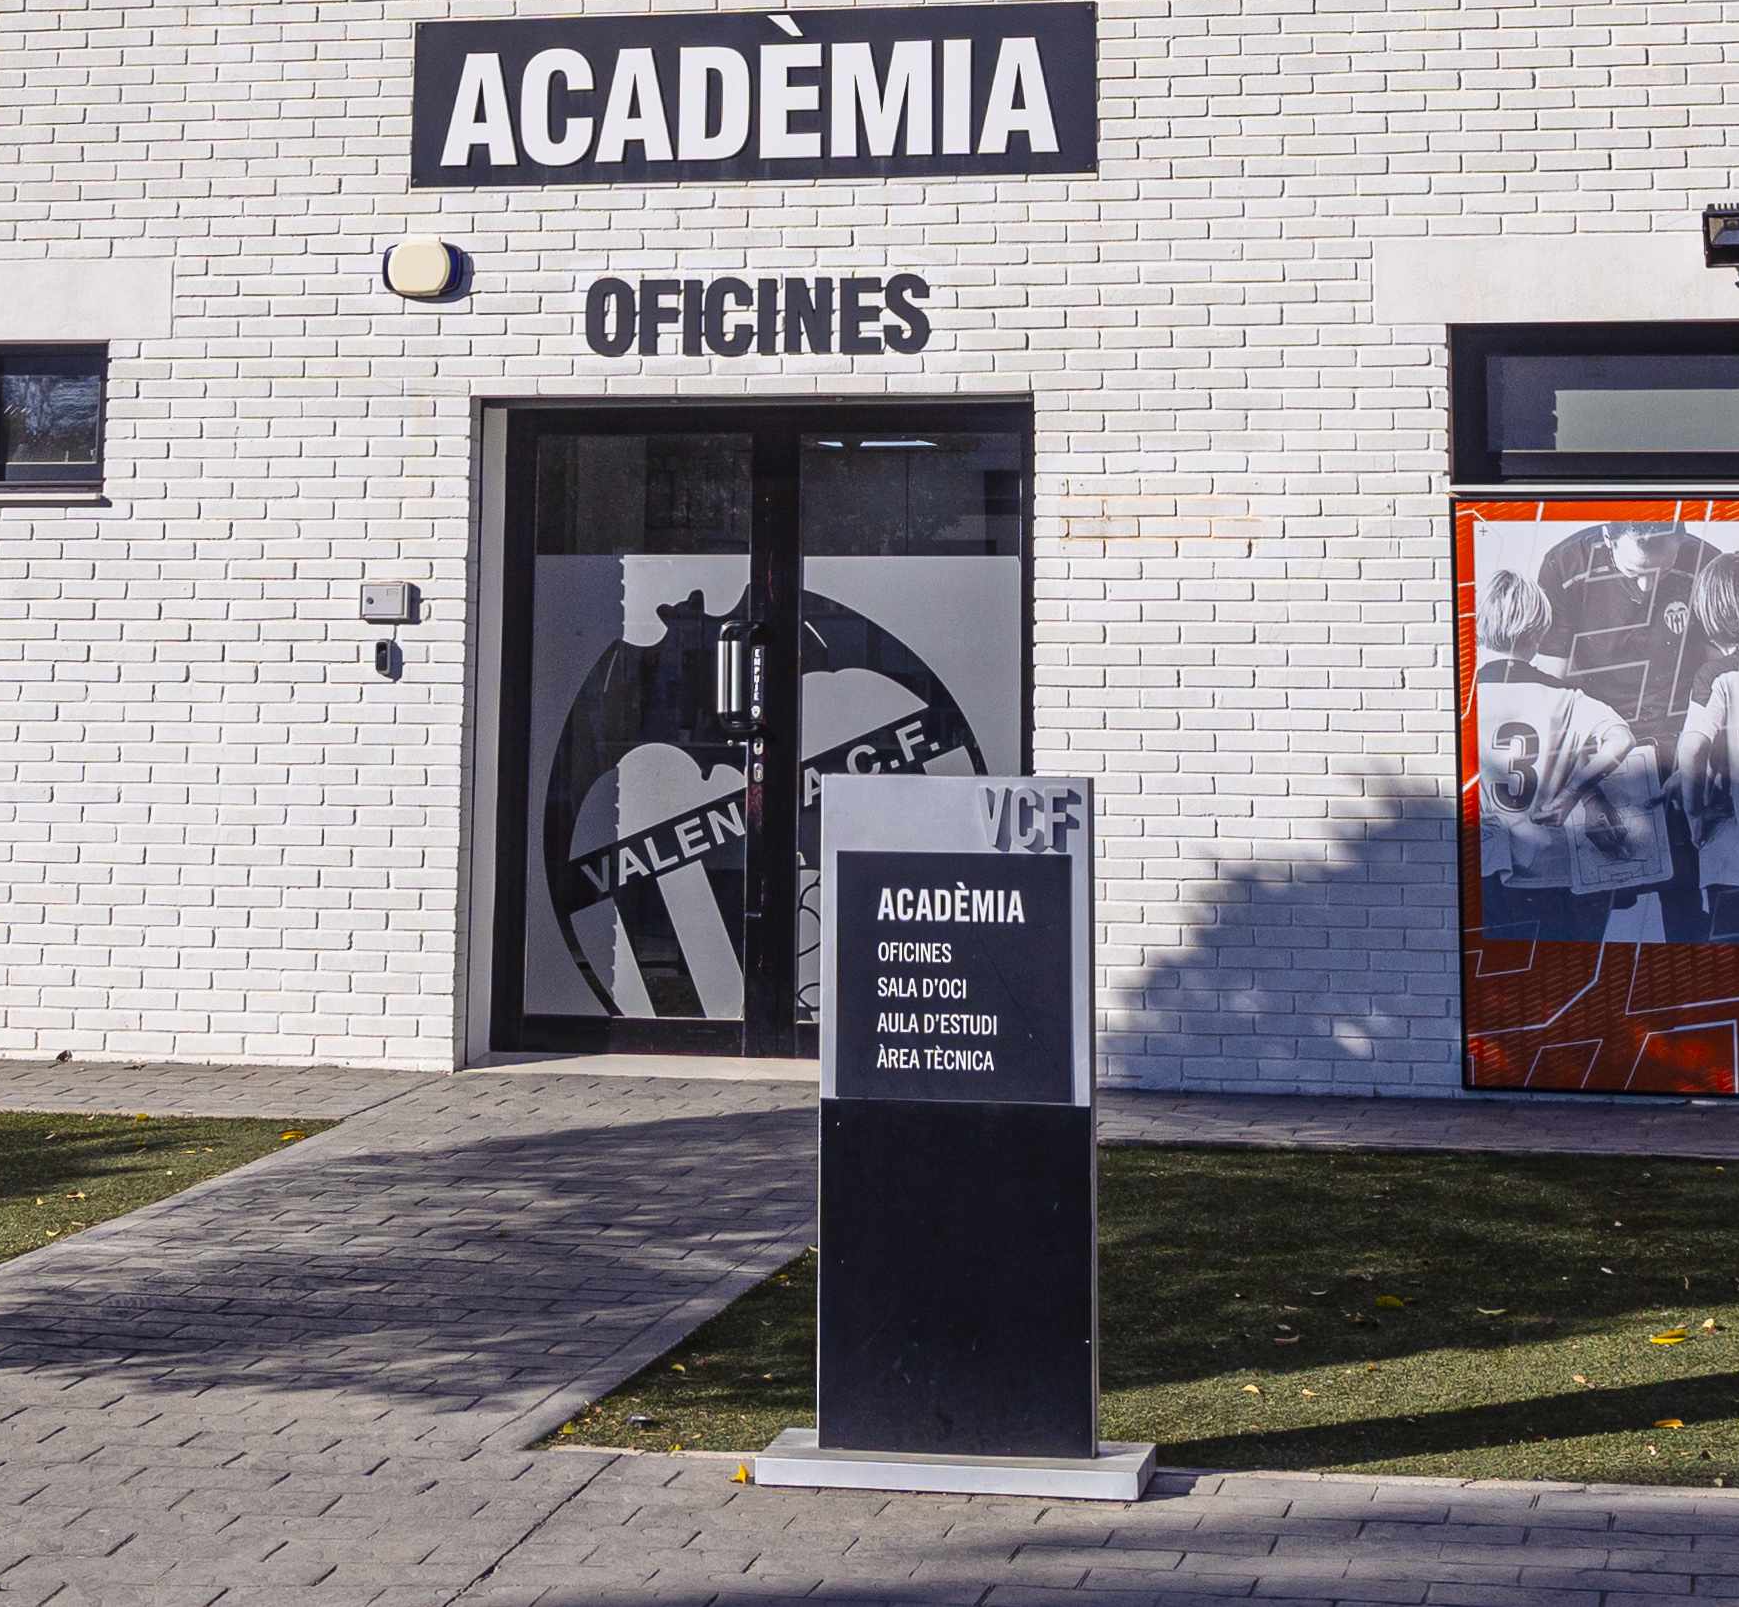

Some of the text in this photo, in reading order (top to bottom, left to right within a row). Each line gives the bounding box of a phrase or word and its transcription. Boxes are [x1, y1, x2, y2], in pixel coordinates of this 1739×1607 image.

[439, 14, 1060, 167] ACADÈMIA
[585, 272, 932, 357] OFICINES
[846, 721, 940, 775] C.F.
[1492, 721, 1541, 812] 3
[979, 785, 1078, 850] VCF
[877, 882, 1026, 923] ACADÈMIA
[878, 942, 952, 963] OFICINES
[877, 977, 967, 999] SALA D'OCI
[877, 1012, 998, 1036] AULA D'ESTUDI
[876, 1044, 995, 1071] ÀREA TÈCNICA
